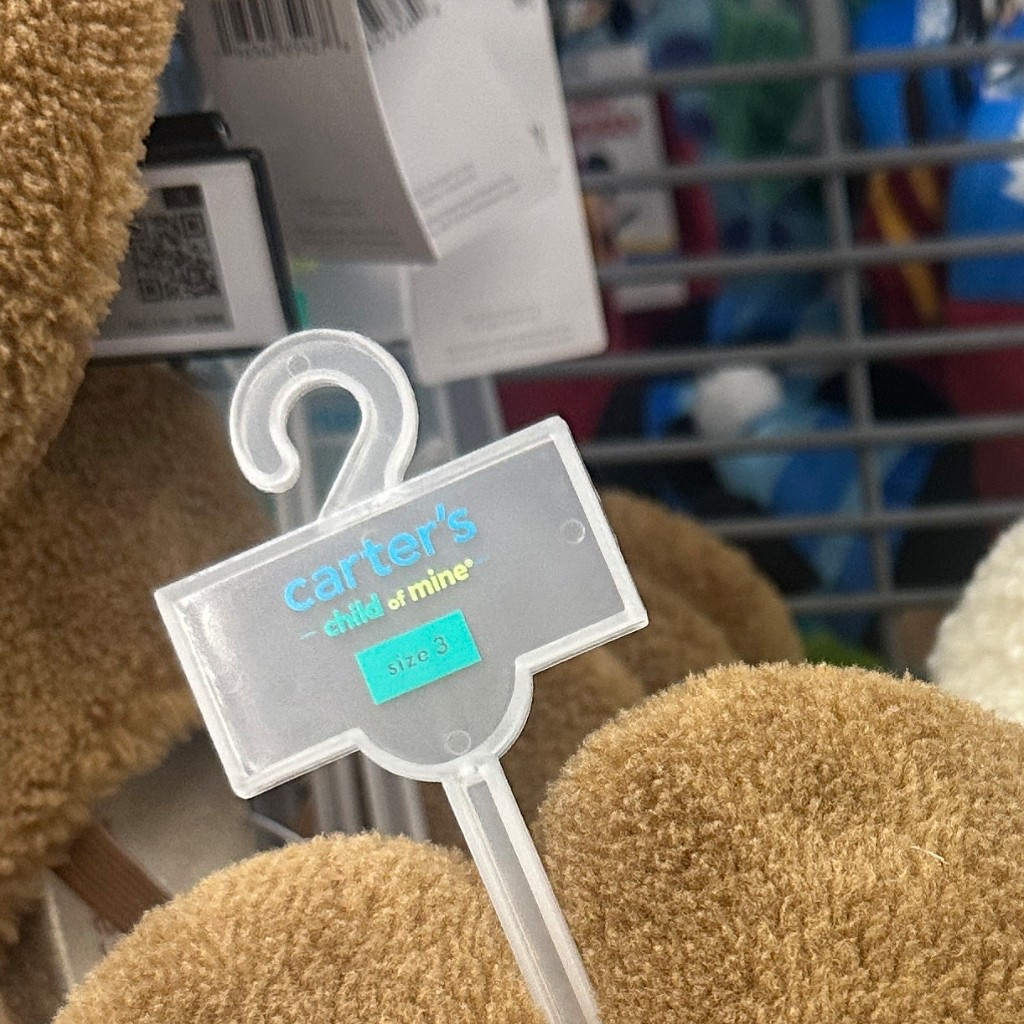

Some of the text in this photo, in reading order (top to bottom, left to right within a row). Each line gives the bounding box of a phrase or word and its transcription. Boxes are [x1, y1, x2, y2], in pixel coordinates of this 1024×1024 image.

[284, 502, 477, 612] carter's
[323, 592, 386, 637] child
[387, 589, 408, 610] of
[388, 636, 448, 676] size 3
